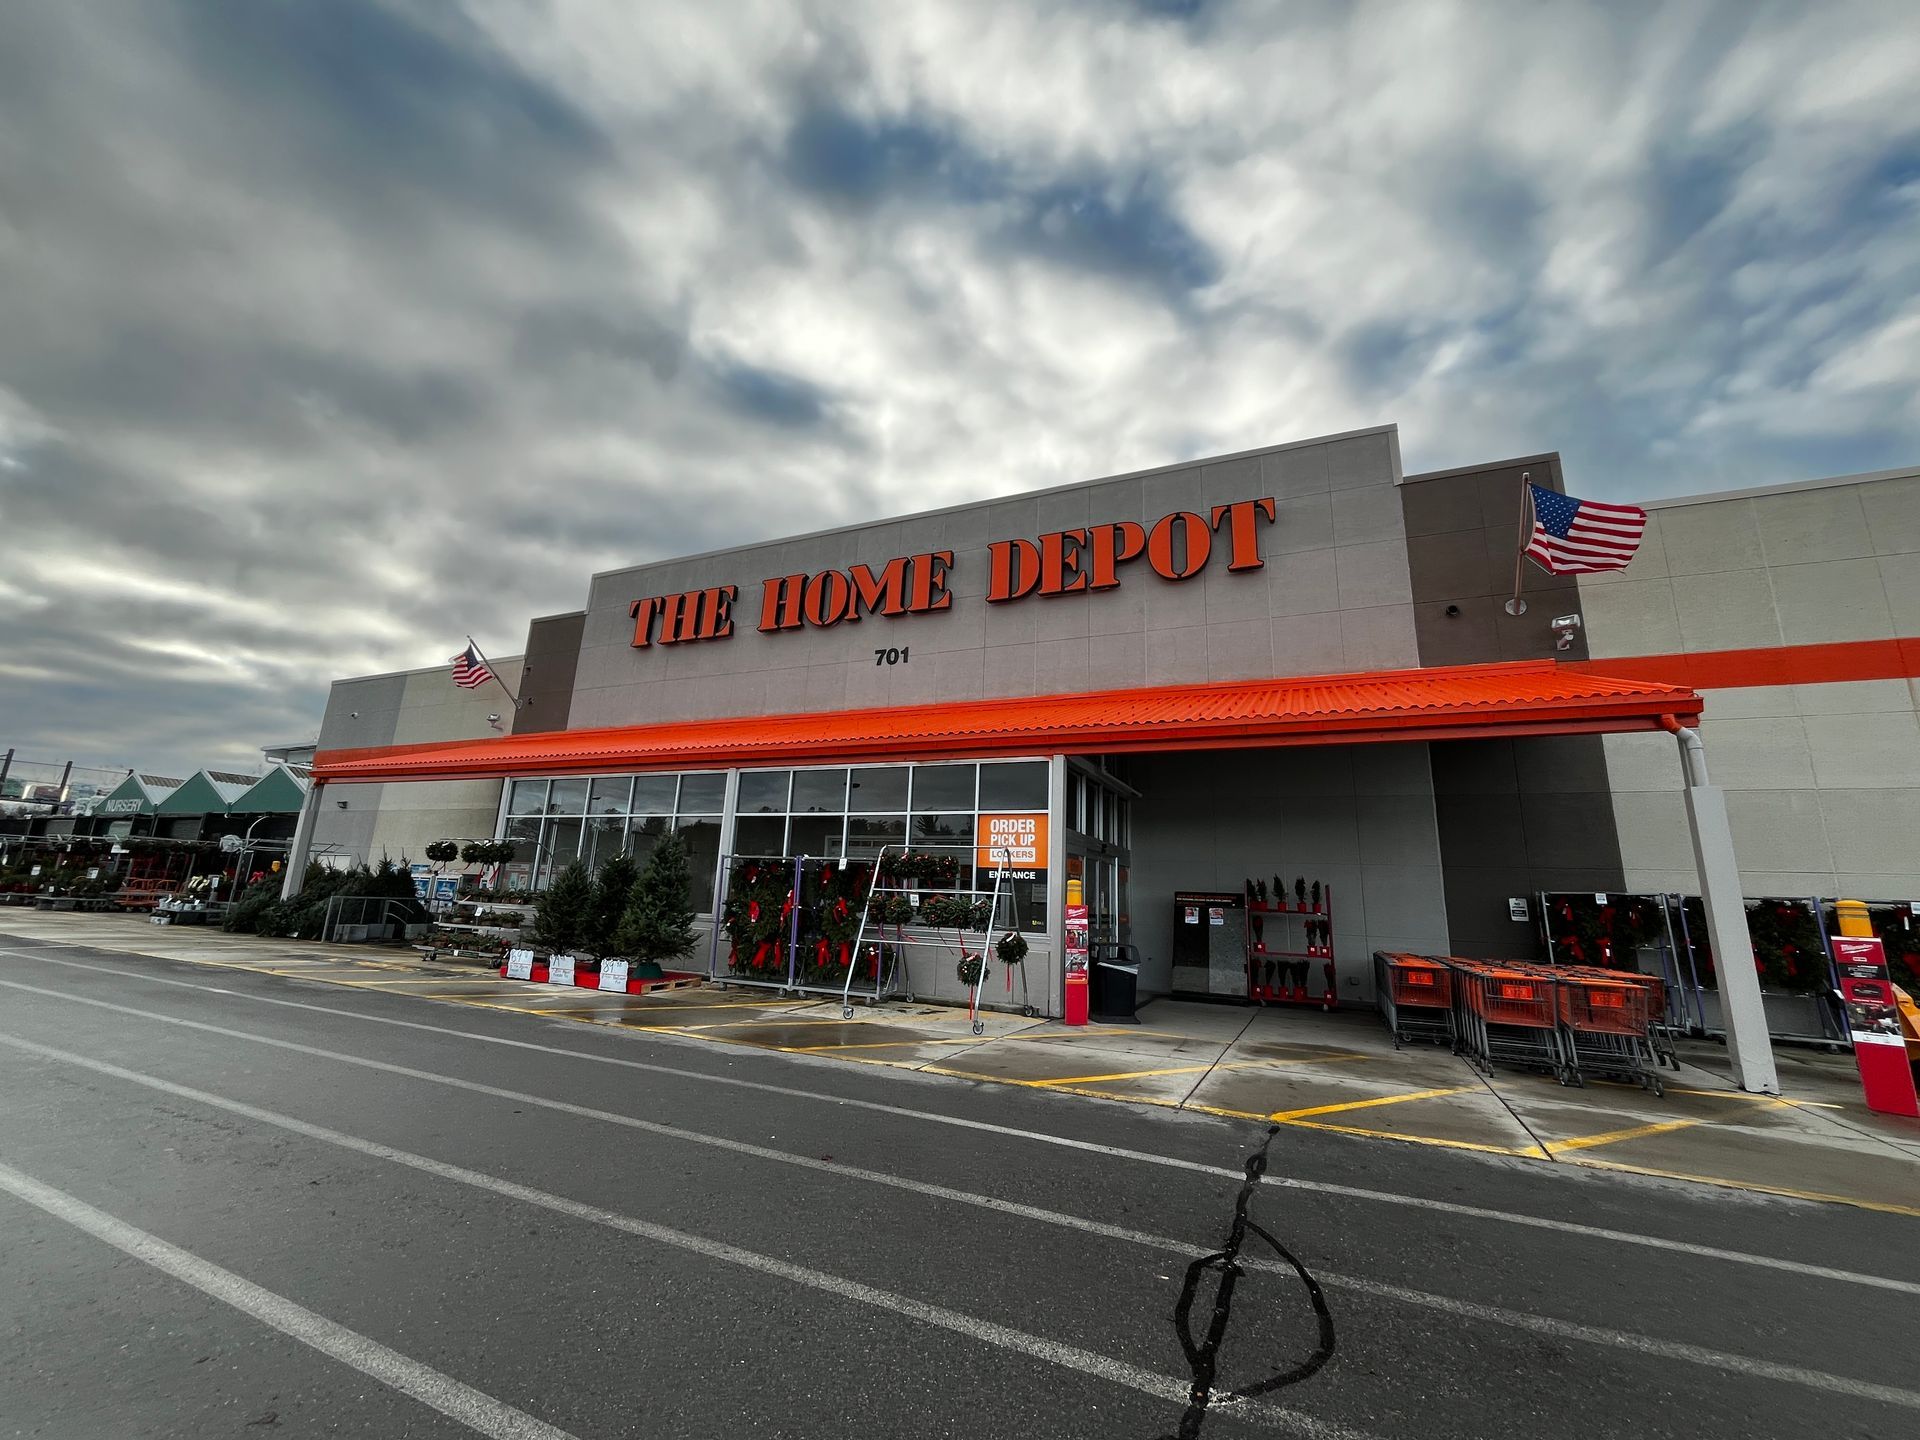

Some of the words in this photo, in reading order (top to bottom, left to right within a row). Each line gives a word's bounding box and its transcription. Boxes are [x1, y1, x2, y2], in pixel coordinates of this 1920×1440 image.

[629, 585, 738, 648] THE
[756, 550, 955, 633] HOME
[985, 497, 1276, 603] DEPOT
[874, 646, 910, 666] 701
[104, 799, 144, 812] NURSERY
[990, 819, 1036, 833] ORDER
[990, 834, 1017, 846] PICK
[1020, 834, 1036, 846] UP
[991, 849, 1034, 859] LOKERS
[988, 870, 1036, 880] ENTRANCE
